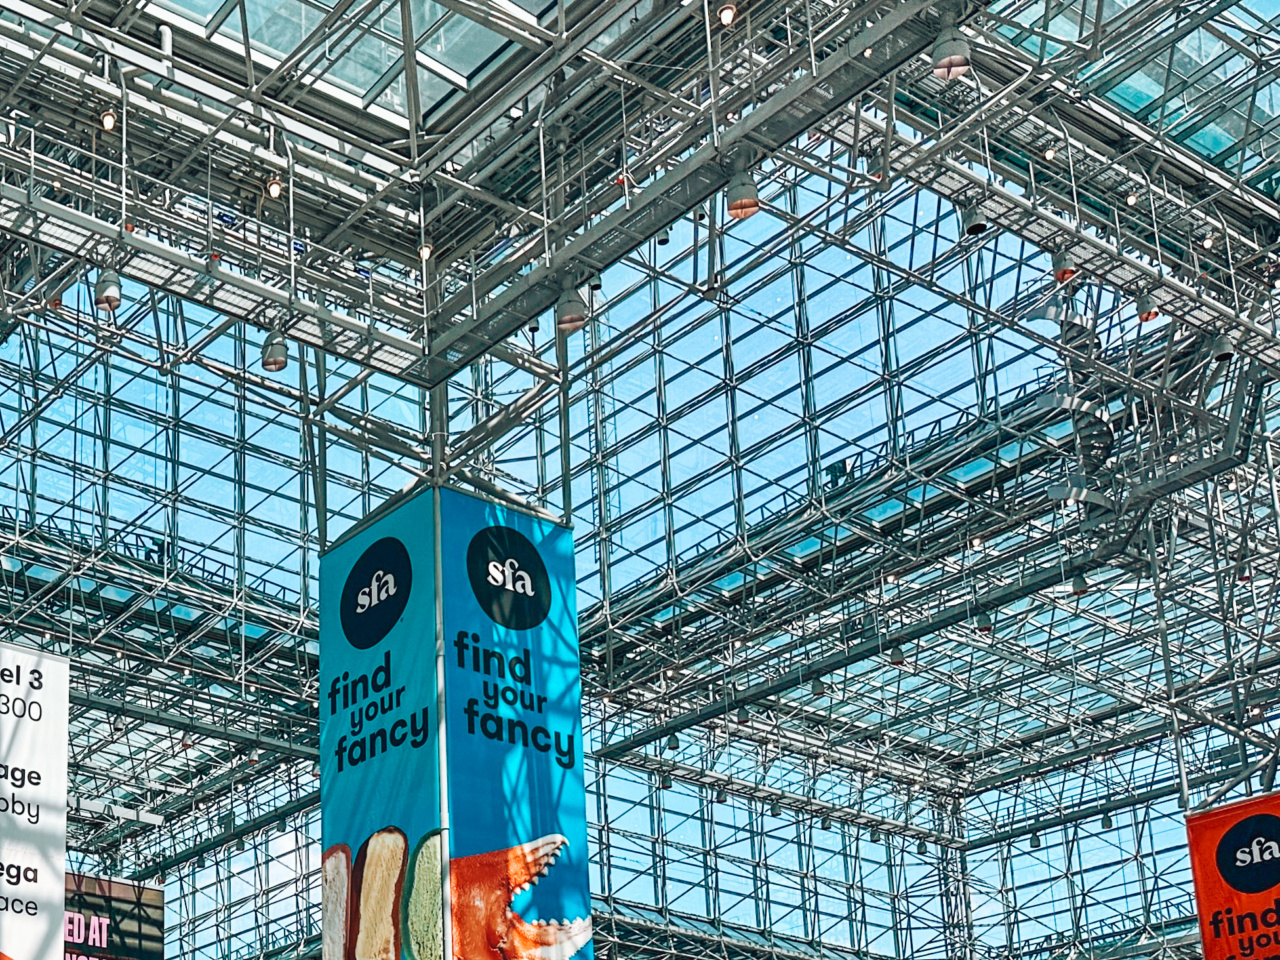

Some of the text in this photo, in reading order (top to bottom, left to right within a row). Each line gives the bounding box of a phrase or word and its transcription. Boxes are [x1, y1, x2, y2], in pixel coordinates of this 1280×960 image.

[355, 570, 398, 614] sfa
[487, 558, 535, 597] sfa
[453, 630, 531, 686] find
[29, 669, 44, 690] 3
[327, 650, 391, 716] find
[483, 680, 547, 714] your
[350, 685, 406, 736] your
[334, 706, 429, 773] fancy
[464, 698, 575, 769] fancy
[1235, 837, 1280, 867] sfa
[87, 914, 111, 948] AT
[1209, 898, 1280, 939] find
